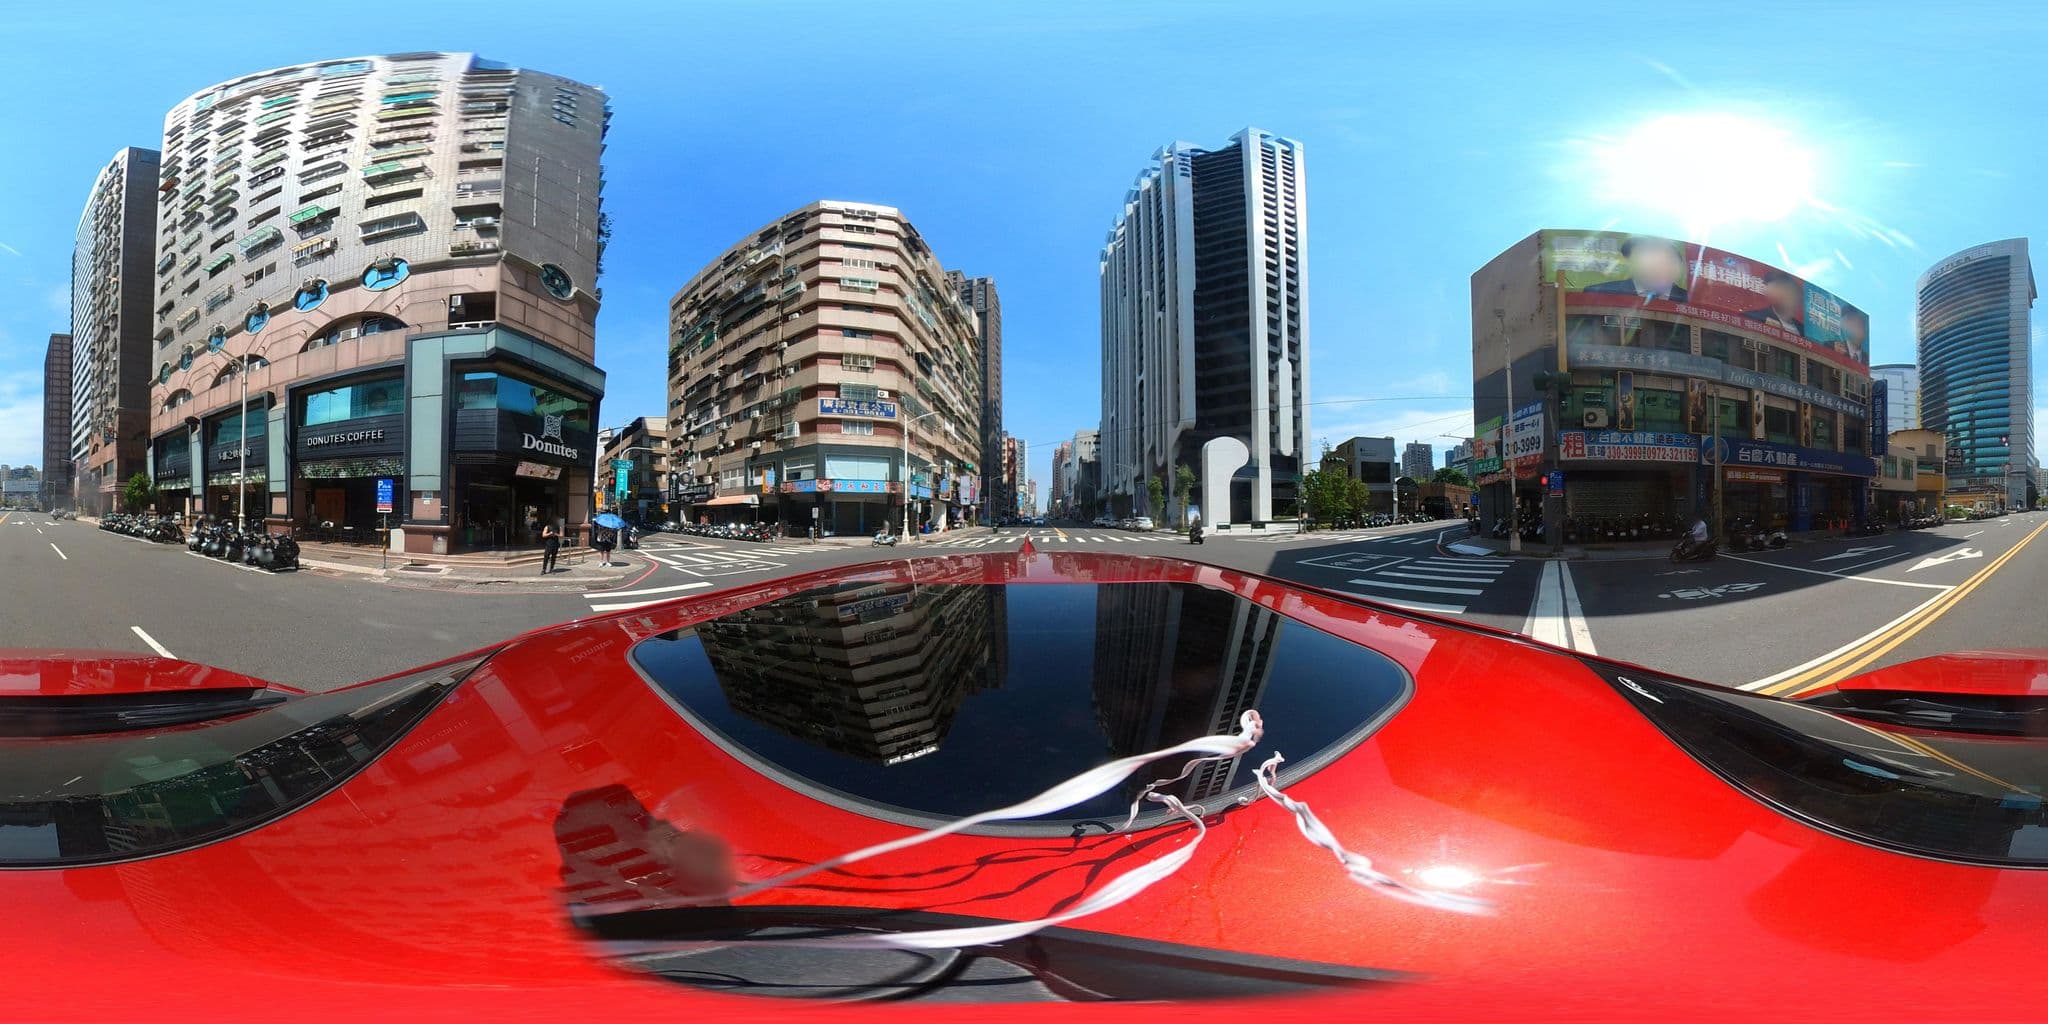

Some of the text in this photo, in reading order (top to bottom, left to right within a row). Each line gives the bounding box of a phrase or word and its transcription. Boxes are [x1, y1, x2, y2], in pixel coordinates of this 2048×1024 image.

[307, 429, 384, 446] DONUTES COFFEE
[522, 432, 578, 460] Donutes
[1504, 435, 1541, 456] 30-3999
[1562, 431, 1586, 458] 租
[1598, 432, 1655, 445] 台慶不動產
[1738, 447, 1798, 466] 台慶不動產
